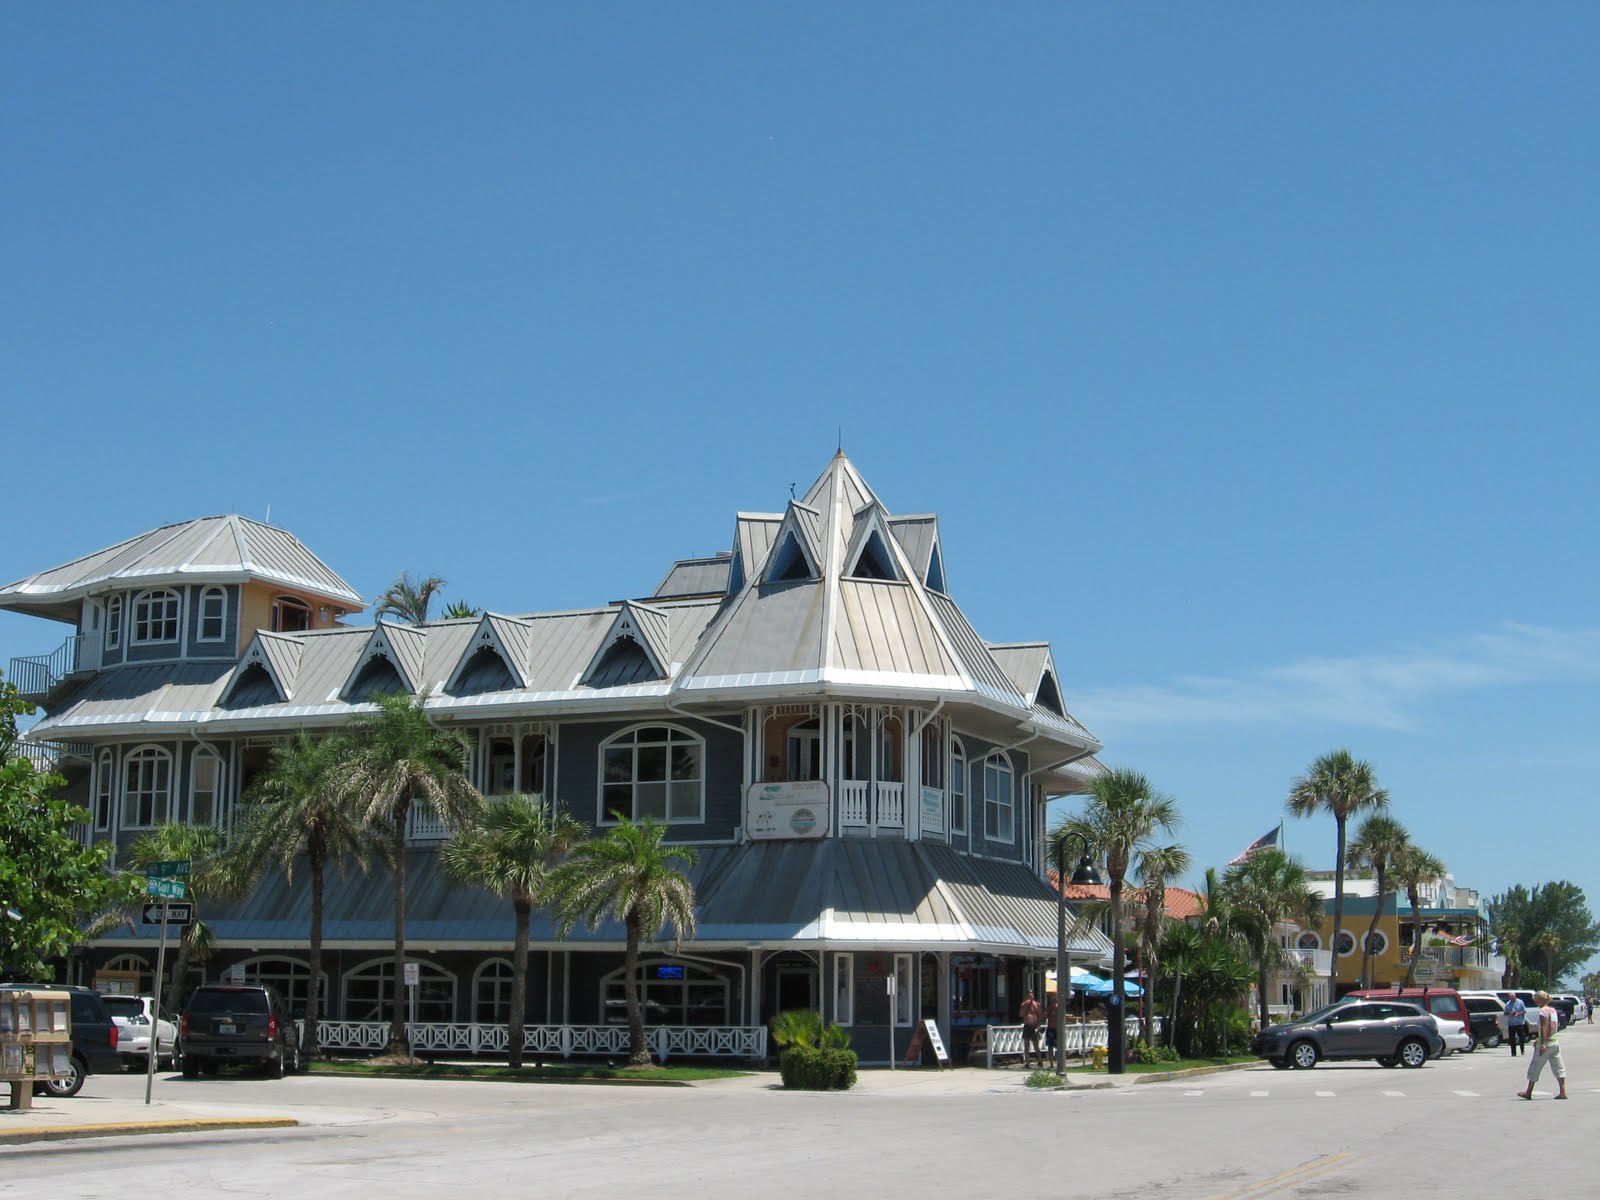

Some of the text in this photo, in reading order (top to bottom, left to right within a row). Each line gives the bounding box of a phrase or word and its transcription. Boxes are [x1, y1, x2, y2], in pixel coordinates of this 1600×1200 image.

[176, 863, 189, 873] AVE
[157, 881, 185, 898] Gulf Way
[171, 910, 186, 918] WAY
